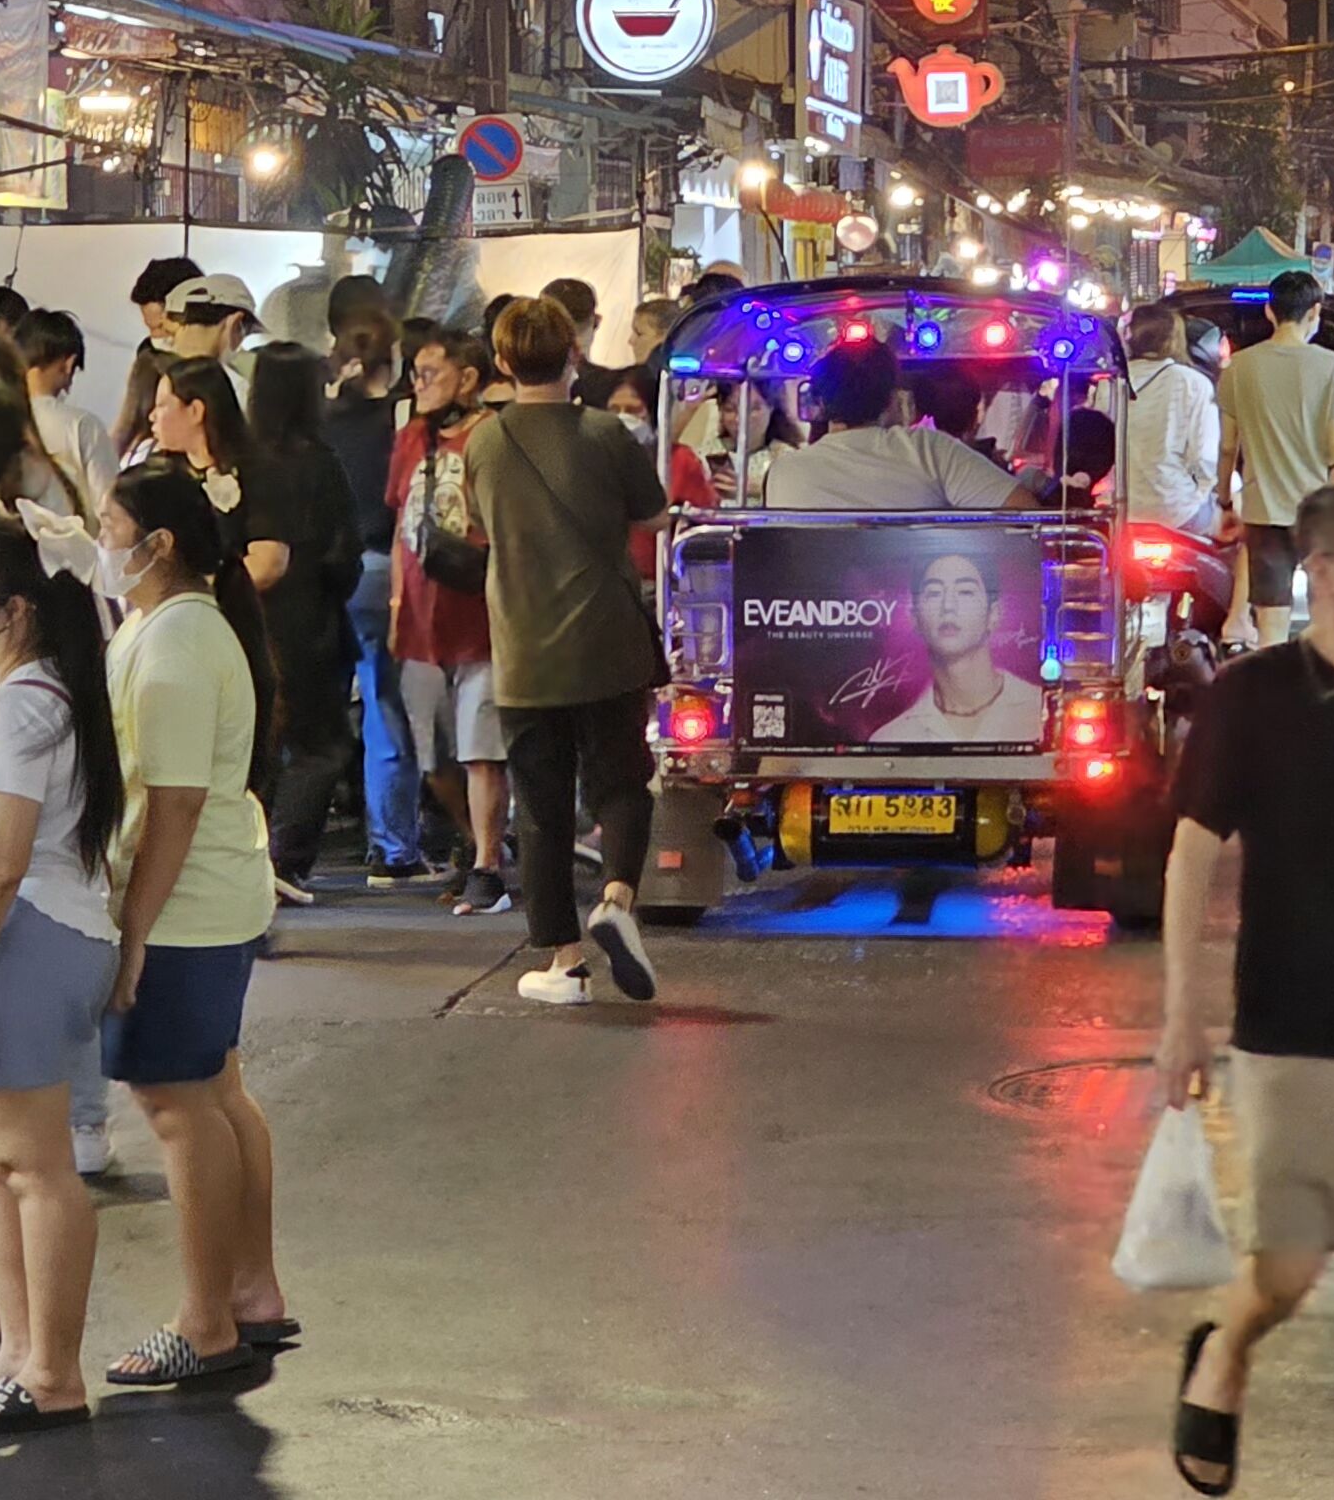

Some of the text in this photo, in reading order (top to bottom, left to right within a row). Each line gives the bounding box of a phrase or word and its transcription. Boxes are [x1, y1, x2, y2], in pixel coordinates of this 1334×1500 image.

[475, 190, 508, 206] ลอด
[743, 599, 898, 627] EVEANDBOY
[767, 631, 784, 640] THE
[787, 631, 825, 640] BEAUTY
